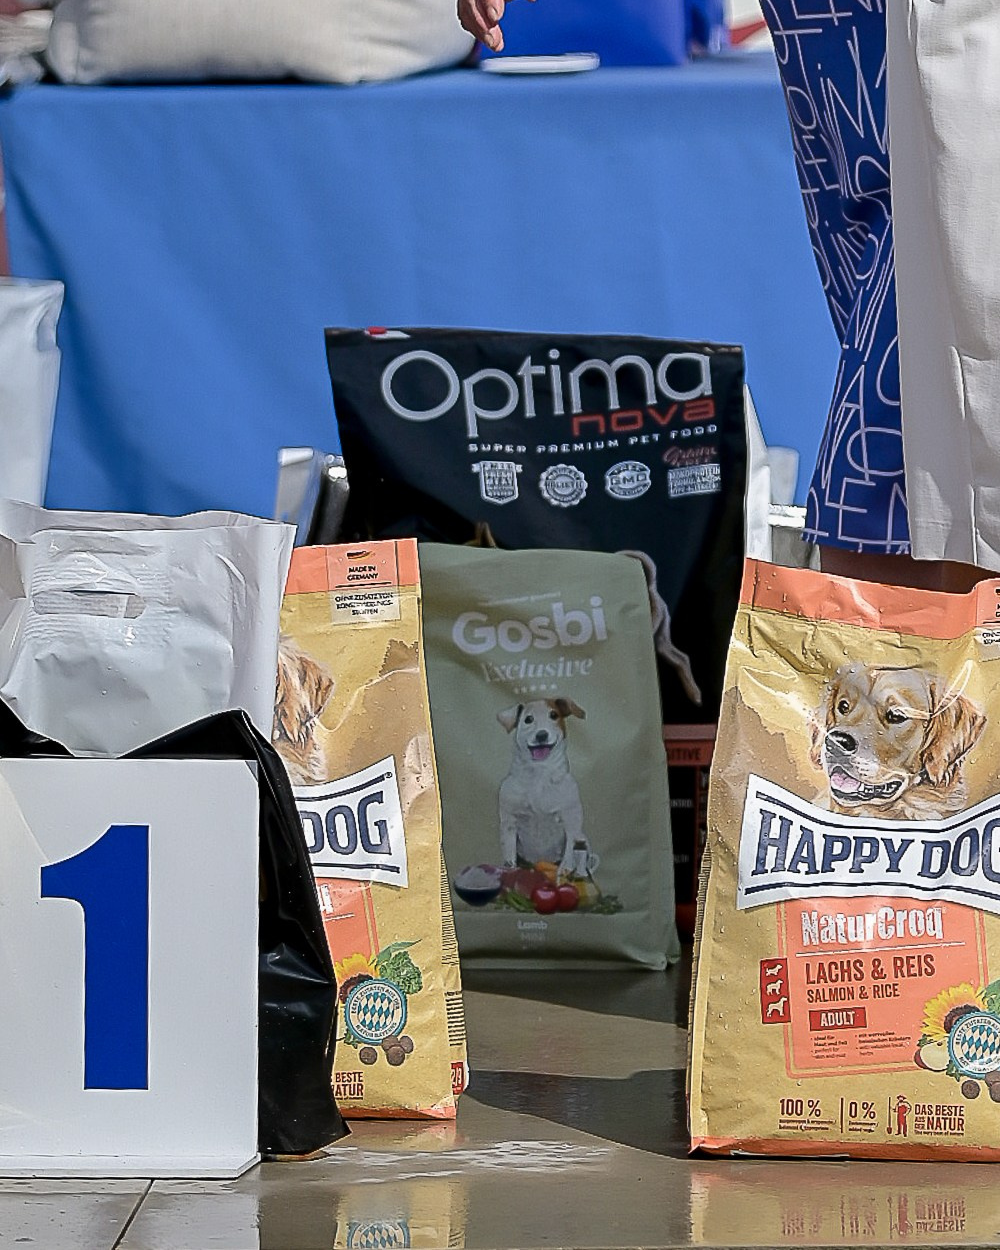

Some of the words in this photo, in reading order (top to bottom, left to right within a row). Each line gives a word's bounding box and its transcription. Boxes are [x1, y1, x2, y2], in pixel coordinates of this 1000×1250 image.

[381, 348, 713, 439] Optima
[572, 397, 716, 437] nova
[468, 442, 527, 454] SUPER
[536, 438, 620, 454] PREMIUM
[628, 432, 662, 446] PET
[670, 424, 718, 440] FOOD
[347, 573, 378, 581] GERMANY
[452, 596, 608, 655] Gosbi
[751, 809, 915, 877] HAPPY
[800, 907, 943, 947] NaturCroq
[41, 824, 149, 1091] 1
[805, 958, 865, 985] LACHS
[871, 958, 887, 980] &
[893, 954, 936, 979] REIS
[807, 986, 855, 1003] SALMON
[859, 985, 869, 1000] &
[873, 983, 900, 999] RICE
[820, 1011, 855, 1027] ADULT
[336, 1071, 364, 1083] BESTE
[780, 1098, 804, 1116] 100
[807, 1100, 821, 1117] %
[849, 1101, 857, 1119] 0
[862, 1102, 876, 1120] %
[914, 1104, 935, 1115] DAS
[936, 1105, 965, 1117] BESTE
[926, 1117, 965, 1131] NATUR
